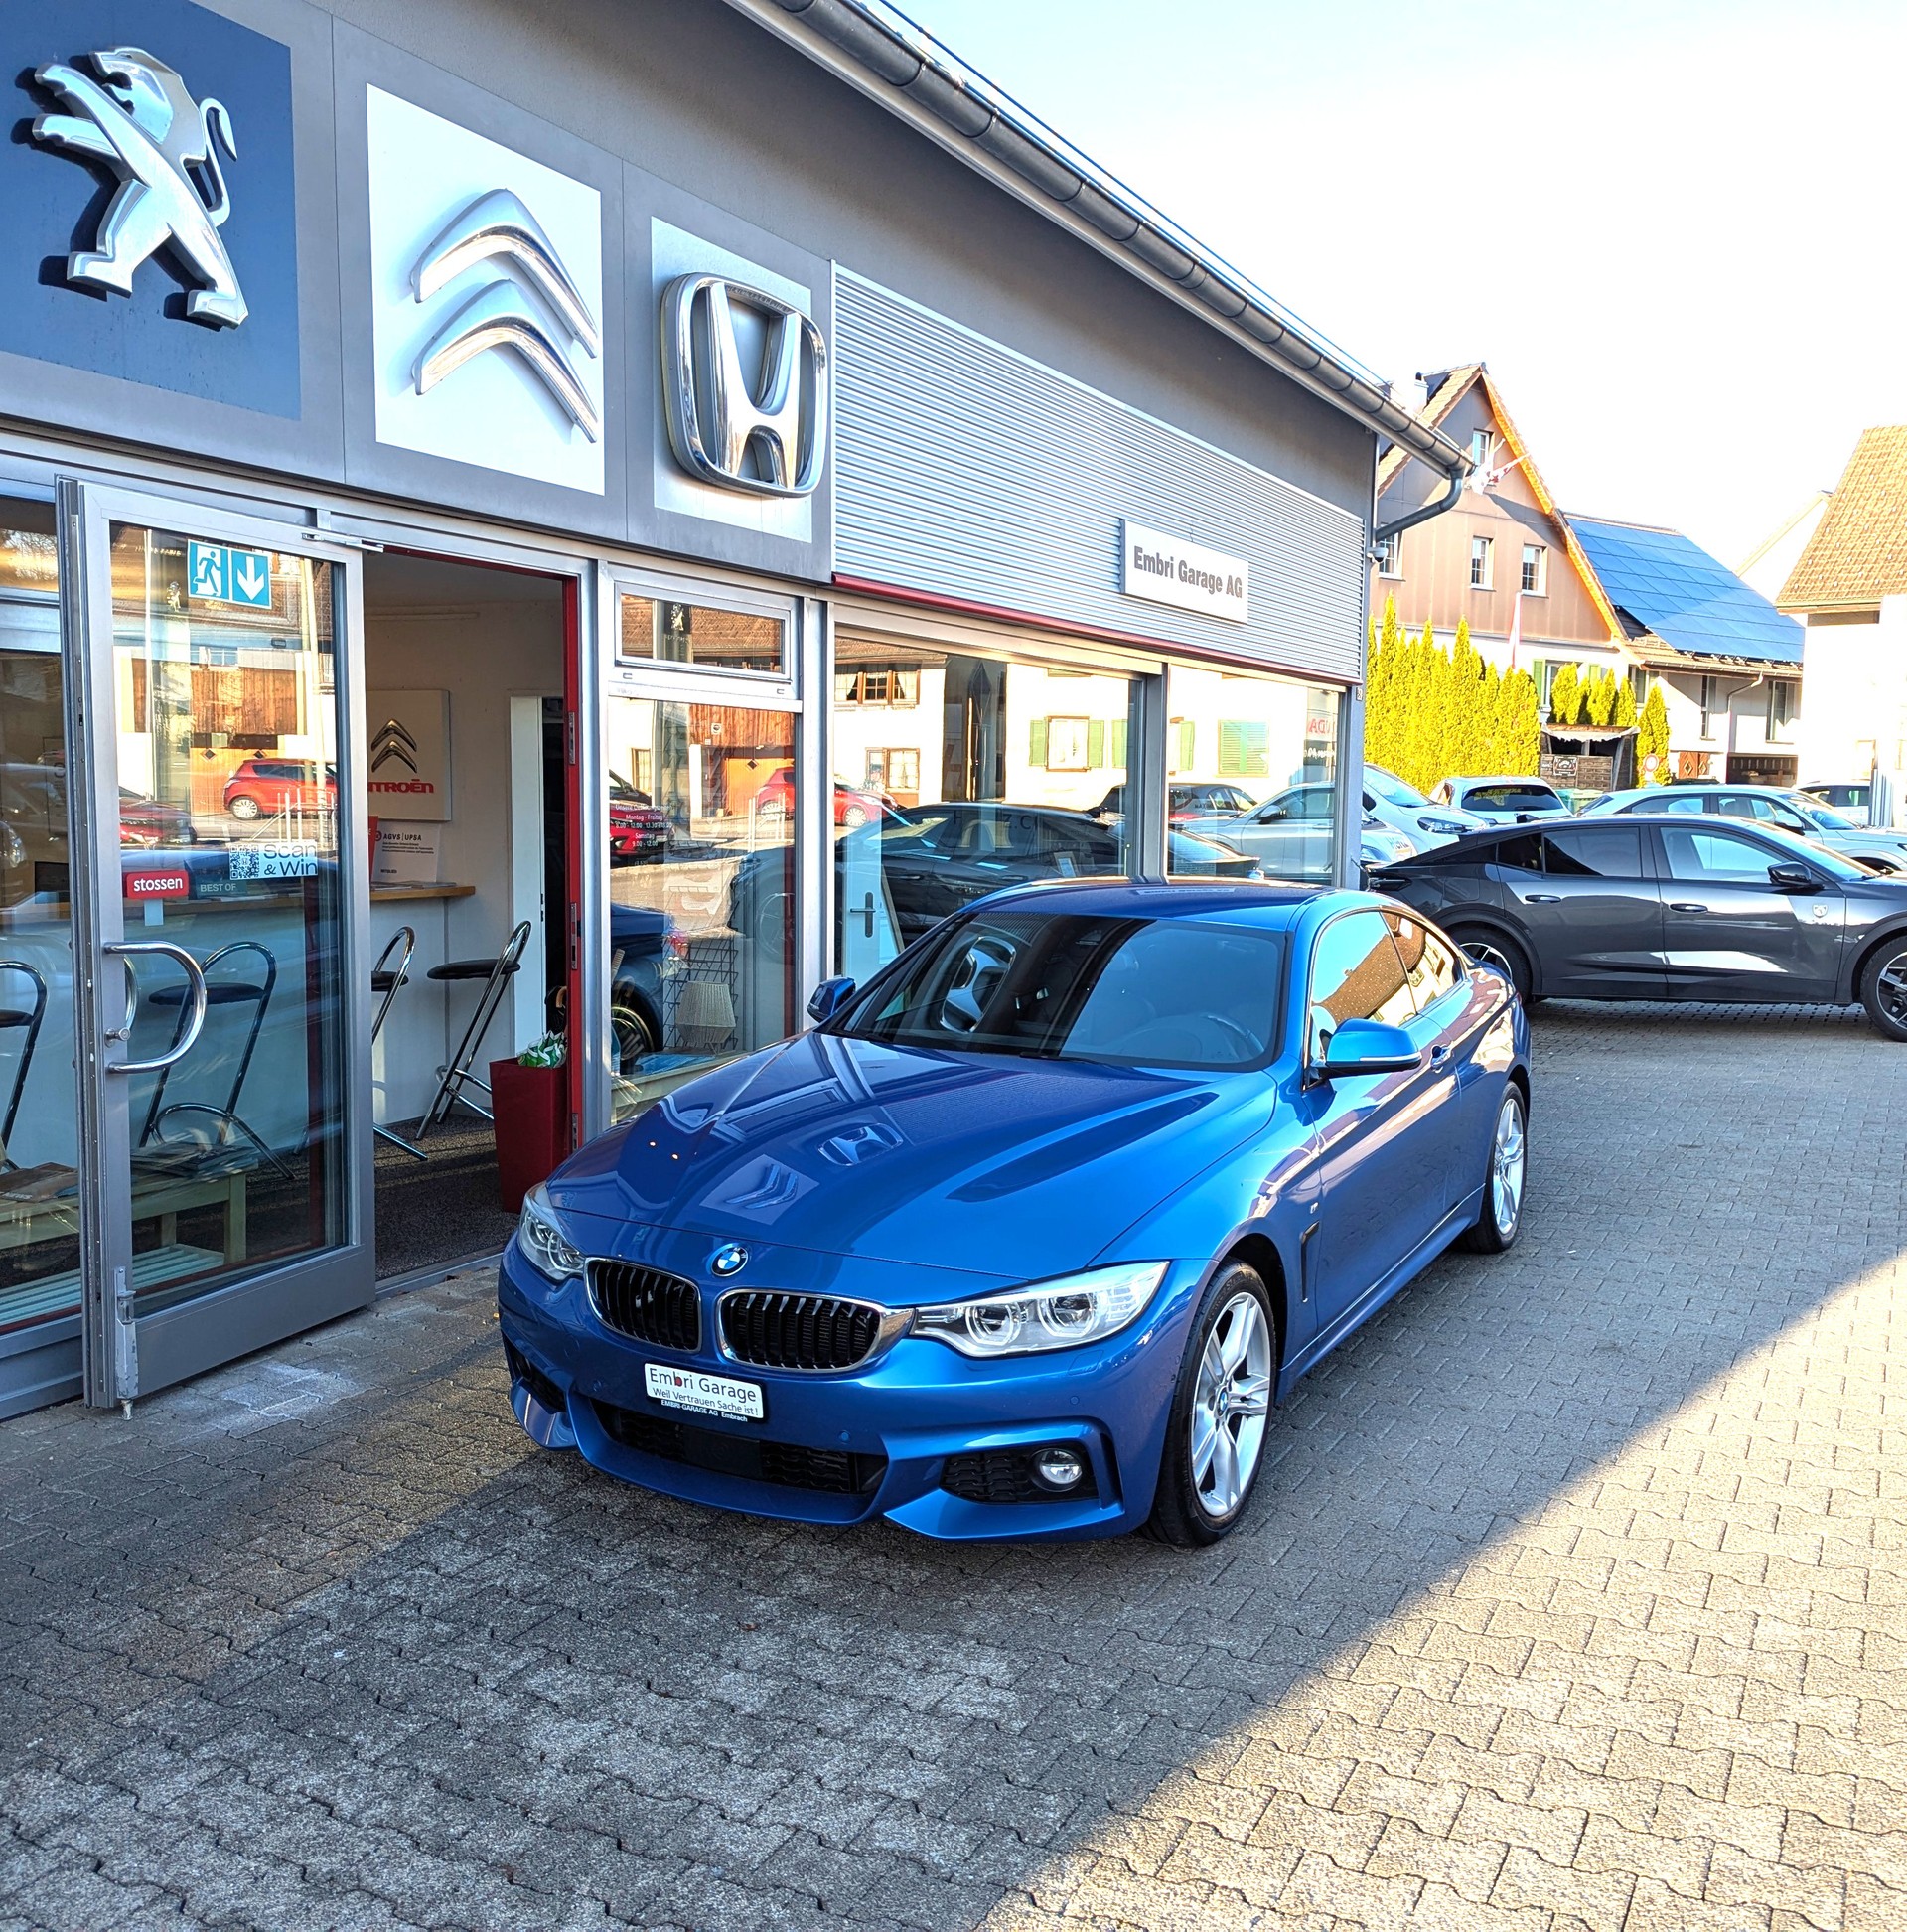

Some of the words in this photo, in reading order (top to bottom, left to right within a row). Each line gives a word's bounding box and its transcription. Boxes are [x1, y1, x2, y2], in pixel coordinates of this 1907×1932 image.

[1133, 545, 1174, 579] Embri
[1178, 559, 1223, 595] Garage
[1226, 574, 1243, 598] AG
[368, 778, 434, 793] ITROËN
[263, 843, 318, 859] Scan
[263, 864, 277, 875] &
[279, 858, 318, 876] Win
[133, 877, 184, 892] stossen
[200, 883, 223, 892] BEST
[224, 883, 237, 892] OF
[649, 1367, 694, 1390] Embri
[698, 1377, 757, 1404] Garage
[652, 1387, 671, 1399] Weil
[672, 1390, 716, 1408] Vertrauen
[717, 1399, 743, 1412] Sache
[660, 1400, 708, 1413] EMBRI-GARAGE
[708, 1409, 719, 1417] AG
[721, 1412, 748, 1422] Embrach
